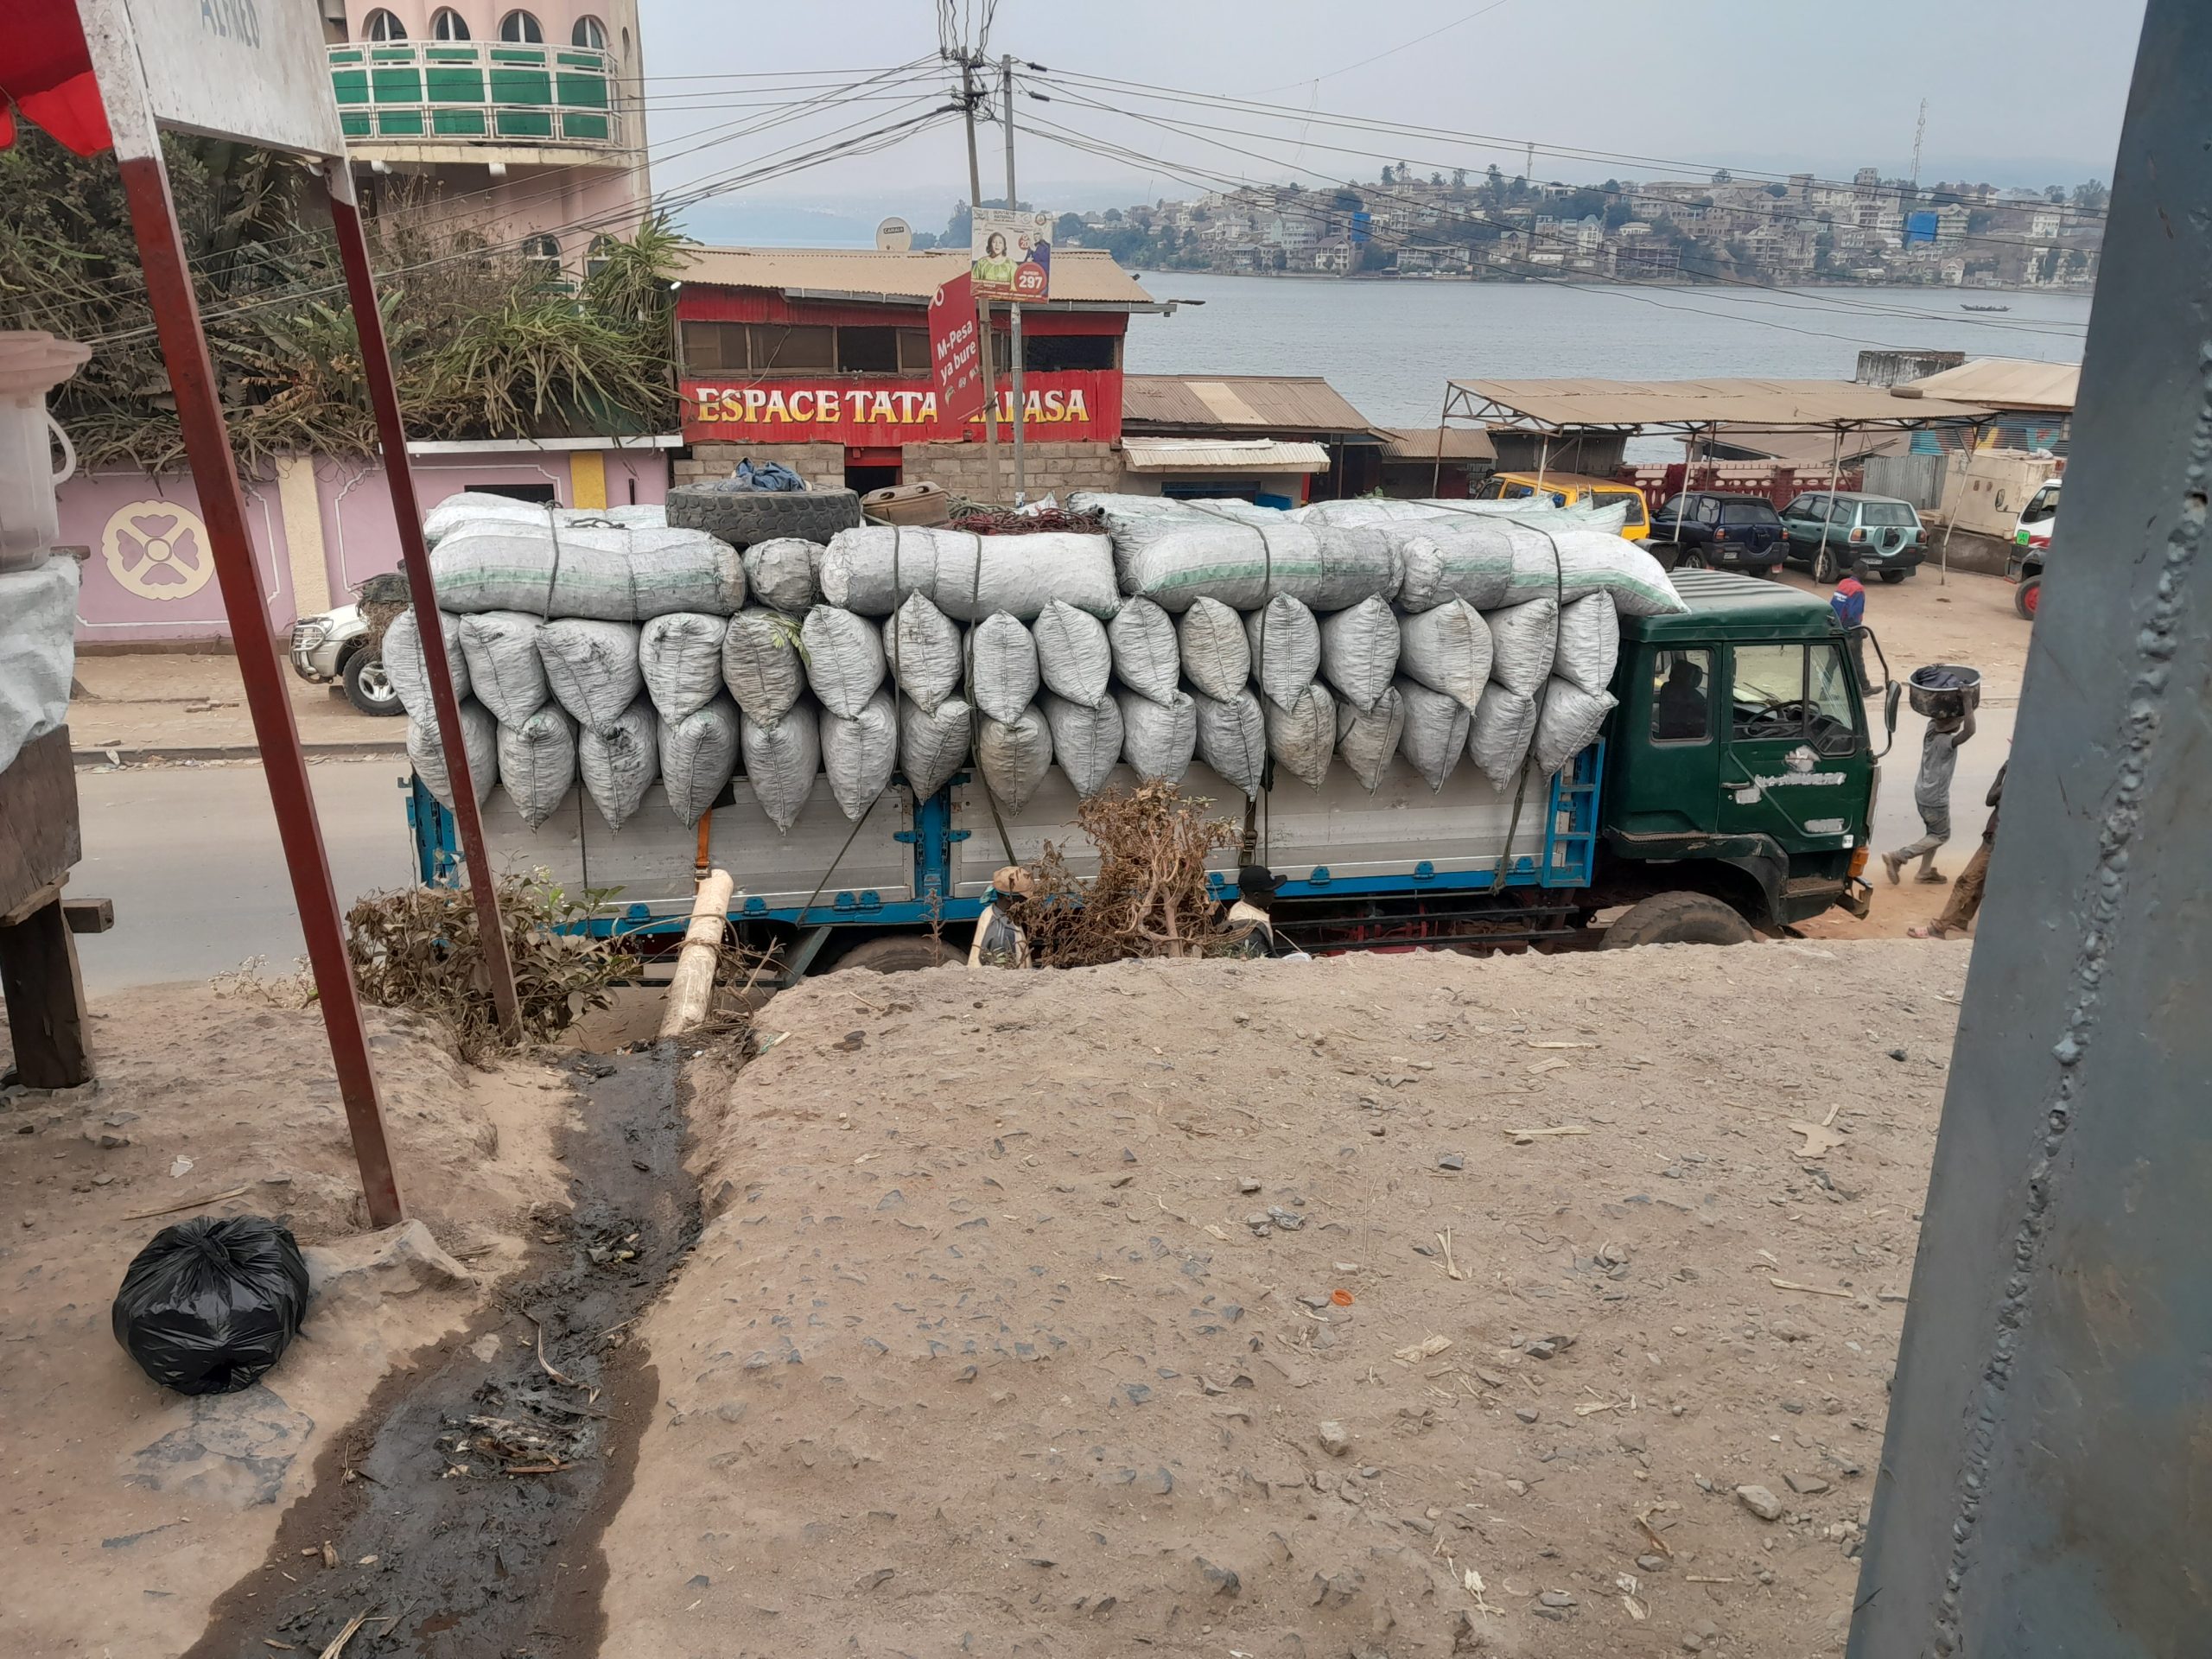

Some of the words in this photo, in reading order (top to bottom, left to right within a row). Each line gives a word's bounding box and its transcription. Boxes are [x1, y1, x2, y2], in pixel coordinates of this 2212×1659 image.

[1019, 276, 1043, 289] 297
[937, 320, 973, 361] M-Pesa
[940, 361, 953, 387] ya
[953, 340, 976, 371] bure
[696, 387, 842, 424] ESPACE
[844, 390, 938, 424] TATA
[969, 389, 1090, 423] APASA
